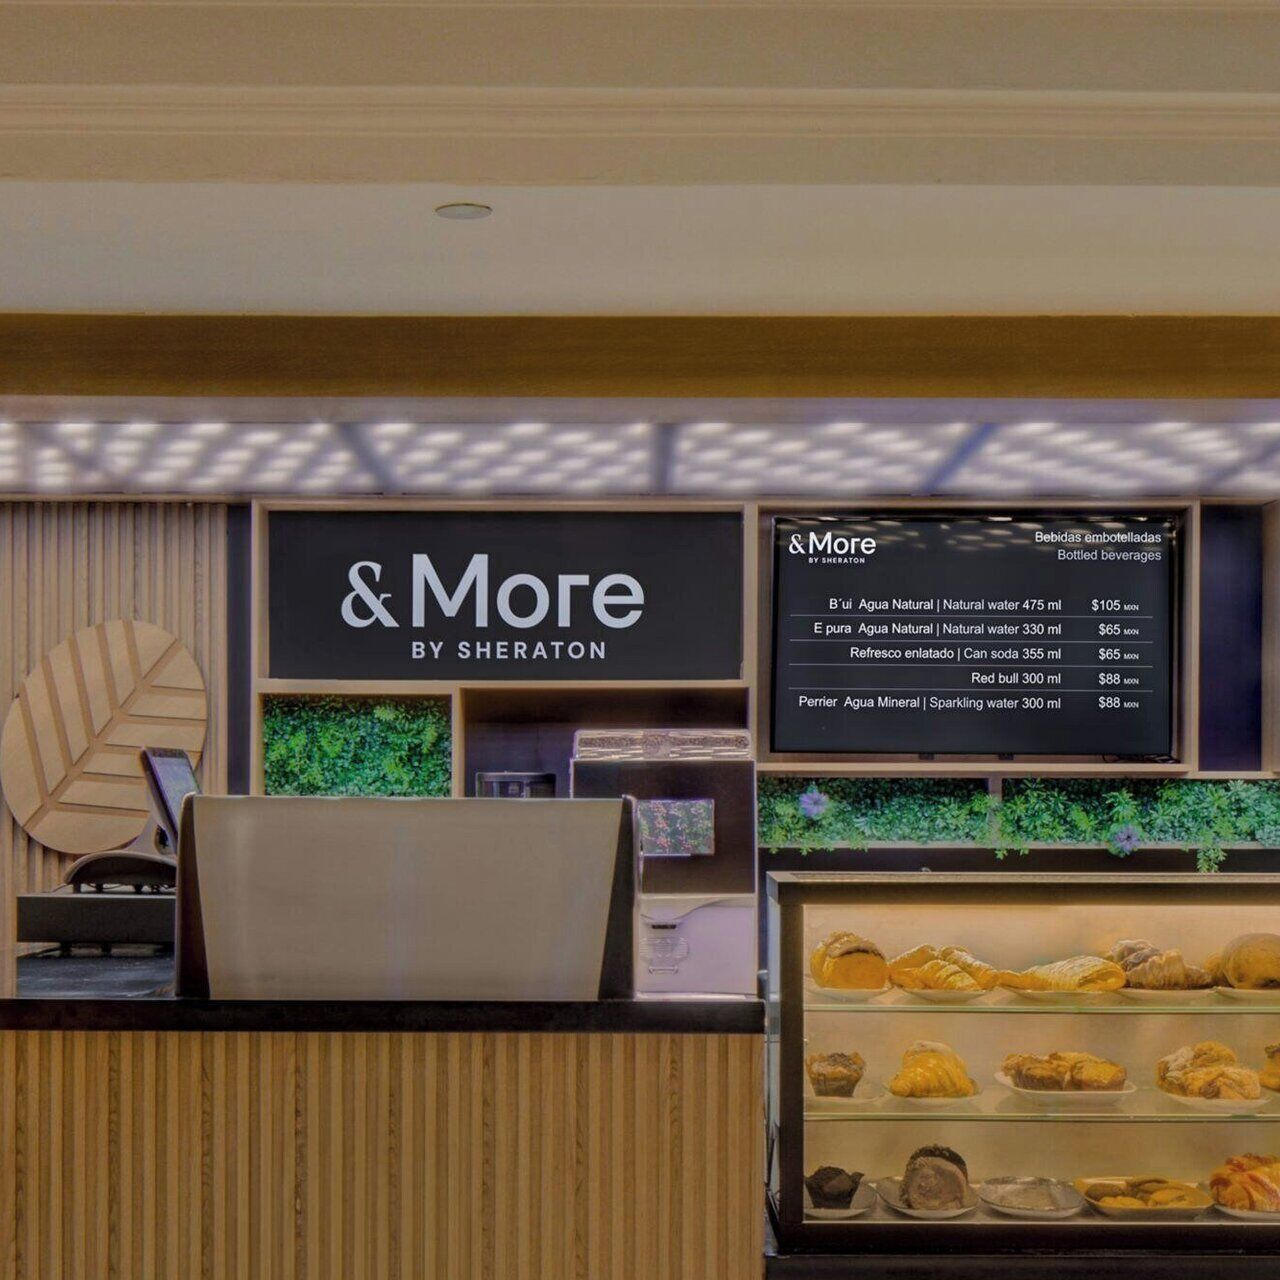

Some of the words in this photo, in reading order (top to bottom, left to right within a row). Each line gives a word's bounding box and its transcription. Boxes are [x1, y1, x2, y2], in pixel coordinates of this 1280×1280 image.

[789, 531, 876, 555] &More
[1035, 531, 1081, 543] Bebidas
[1084, 532, 1162, 543] embotelladas
[808, 556, 819, 564] BY
[821, 556, 866, 564] SHERATON
[1057, 549, 1098, 561] Bottled
[1101, 550, 1162, 563] beverages
[340, 553, 645, 629] &More
[858, 598, 889, 612] Agua
[892, 599, 934, 610] Natural
[943, 599, 985, 611] Natural
[987, 600, 1020, 611] water
[1022, 600, 1045, 611] 475
[1047, 600, 1062, 611] ml
[1091, 599, 1121, 612] $105
[813, 622, 823, 634] E
[825, 624, 852, 636] pura
[857, 622, 889, 636] Agua
[891, 623, 934, 634] Natural
[942, 623, 985, 634] Natural
[987, 624, 1020, 635] water
[1022, 624, 1045, 635] 330
[1047, 624, 1062, 635] ml
[1098, 623, 1121, 637] $65
[1123, 628, 1140, 636] MXN
[411, 641, 444, 659] BY
[457, 641, 606, 660] SHERATON
[850, 646, 902, 659] Refresco
[904, 647, 955, 659] enlatado
[963, 647, 988, 659] Can
[990, 648, 1019, 660] soda
[1022, 648, 1045, 660] 355
[1047, 648, 1062, 660] ml
[1098, 647, 1121, 661] $65
[971, 672, 995, 684] Red
[998, 672, 1019, 684] bull
[1022, 672, 1044, 685] 300
[1047, 673, 1061, 684] ml
[1098, 672, 1121, 686] $88
[798, 695, 839, 708] Perrier
[843, 696, 875, 710] Agua
[877, 696, 920, 708] Mineral
[929, 696, 984, 711] Sparkling
[986, 697, 1019, 709] water
[1021, 697, 1044, 709] 300
[1047, 697, 1061, 709] ml
[1098, 695, 1121, 709] $88
[1123, 701, 1139, 709] MXN
